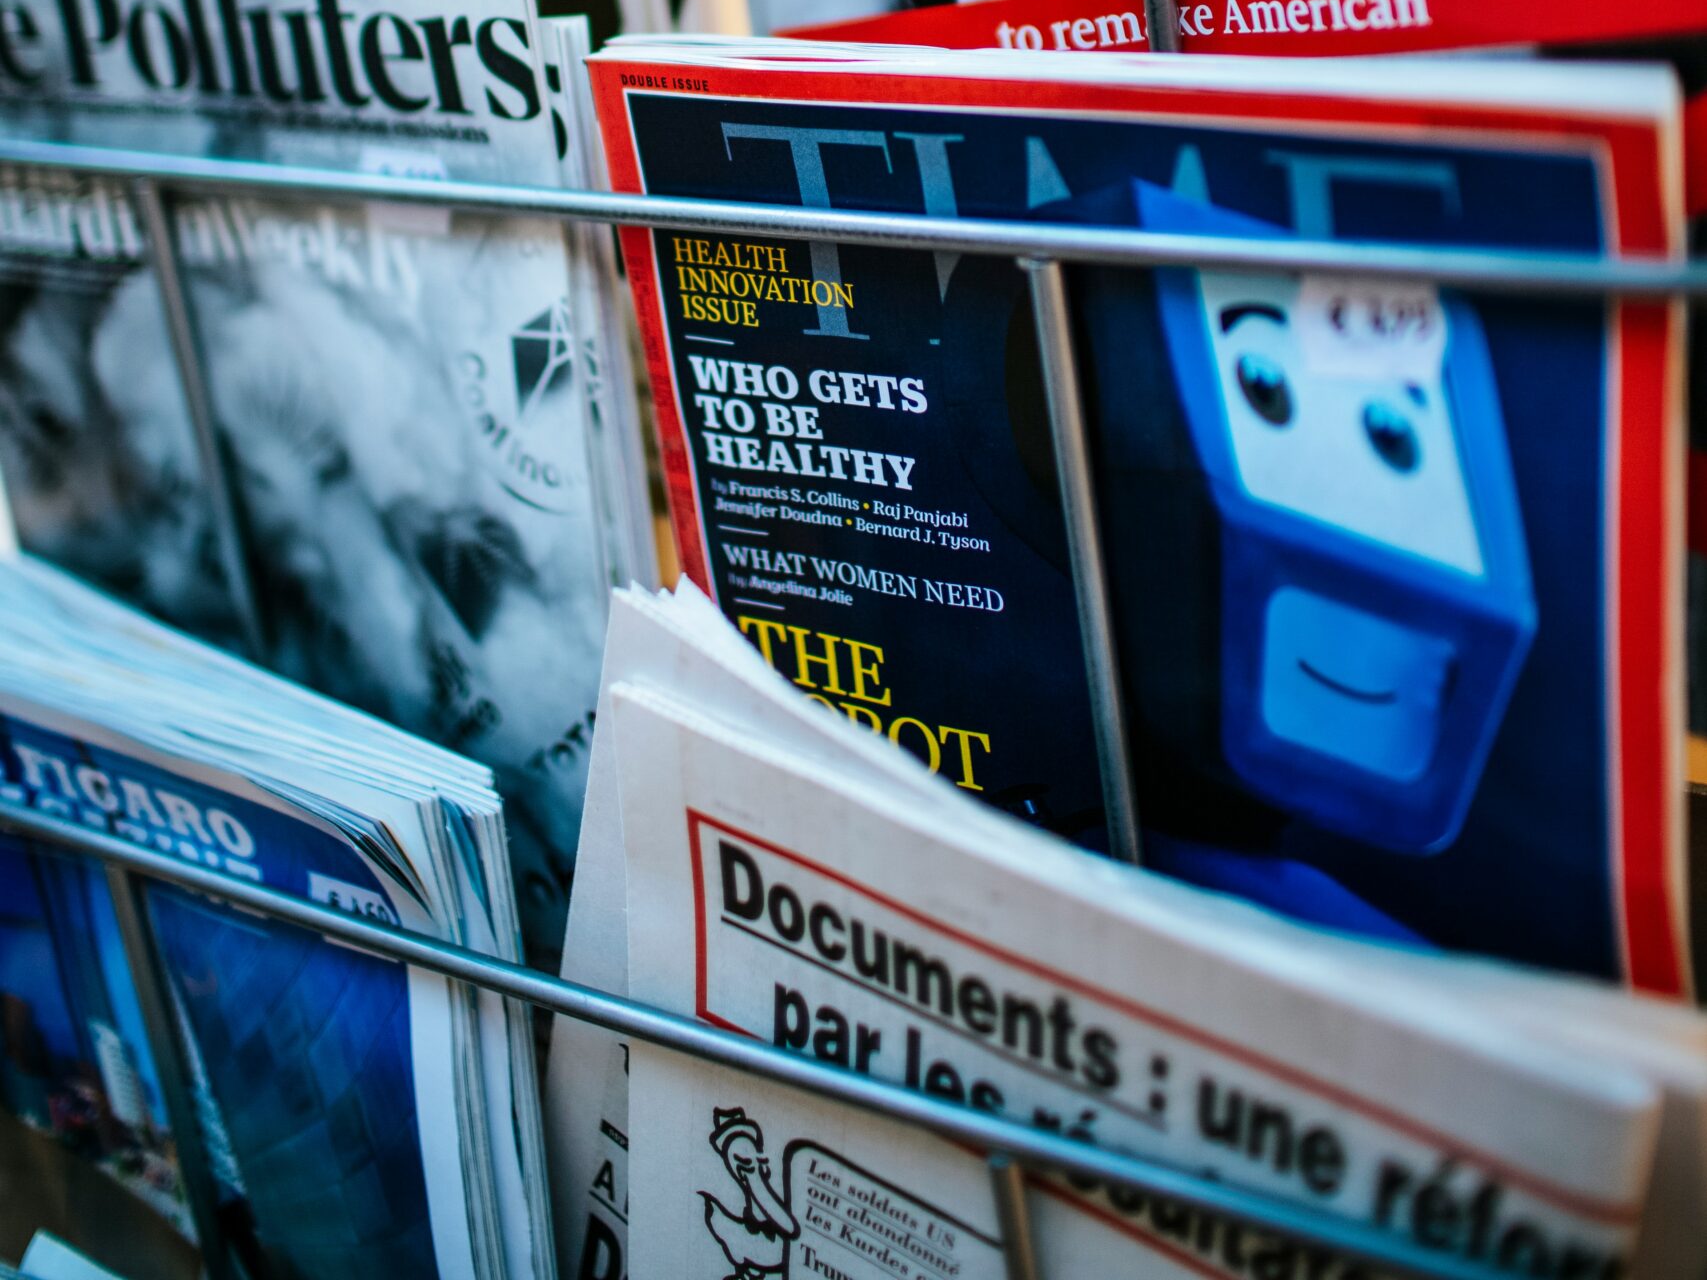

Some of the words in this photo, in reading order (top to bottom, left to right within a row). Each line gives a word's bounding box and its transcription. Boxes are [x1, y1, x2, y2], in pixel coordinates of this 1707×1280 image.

[996, 20, 1043, 50] to
[621, 74, 668, 88] DOUBLE
[672, 77, 710, 92] ISSUE
[672, 237, 789, 274] HEALTH
[676, 267, 857, 310] INNOVATION
[681, 294, 761, 329] ISSUE
[688, 355, 799, 400] WHO
[809, 369, 928, 414] GETS
[695, 392, 756, 434] TO
[762, 402, 824, 440] BE
[702, 430, 916, 491] HEALTHY
[714, 496, 777, 520] Jennifer
[779, 503, 843, 527] Doudna
[855, 517, 921, 543] Bernard
[922, 529, 936, 545] J.
[938, 531, 991, 552] Tyson
[729, 481, 789, 501] Francis
[790, 487, 805, 503] S.
[807, 490, 860, 511] Collins
[873, 500, 901, 521] Raj
[904, 506, 969, 529] Panjabi
[720, 542, 807, 576] WHAT
[809, 556, 918, 600] WOMEN
[922, 579, 1005, 613] NEED
[749, 574, 818, 600] Angelina
[818, 586, 854, 607] Jolie
[738, 615, 892, 707] THE
[718, 838, 1120, 1090] Documents
[1196, 1074, 1348, 1198] une
[774, 981, 883, 1078] par
[807, 1186, 840, 1210] ont
[846, 1206, 961, 1277] abandonné
[808, 1158, 841, 1188] Les
[847, 1183, 919, 1231] soldats
[926, 1220, 956, 1252] US
[805, 1205, 832, 1233] les
[839, 1223, 910, 1276] Kurdes
